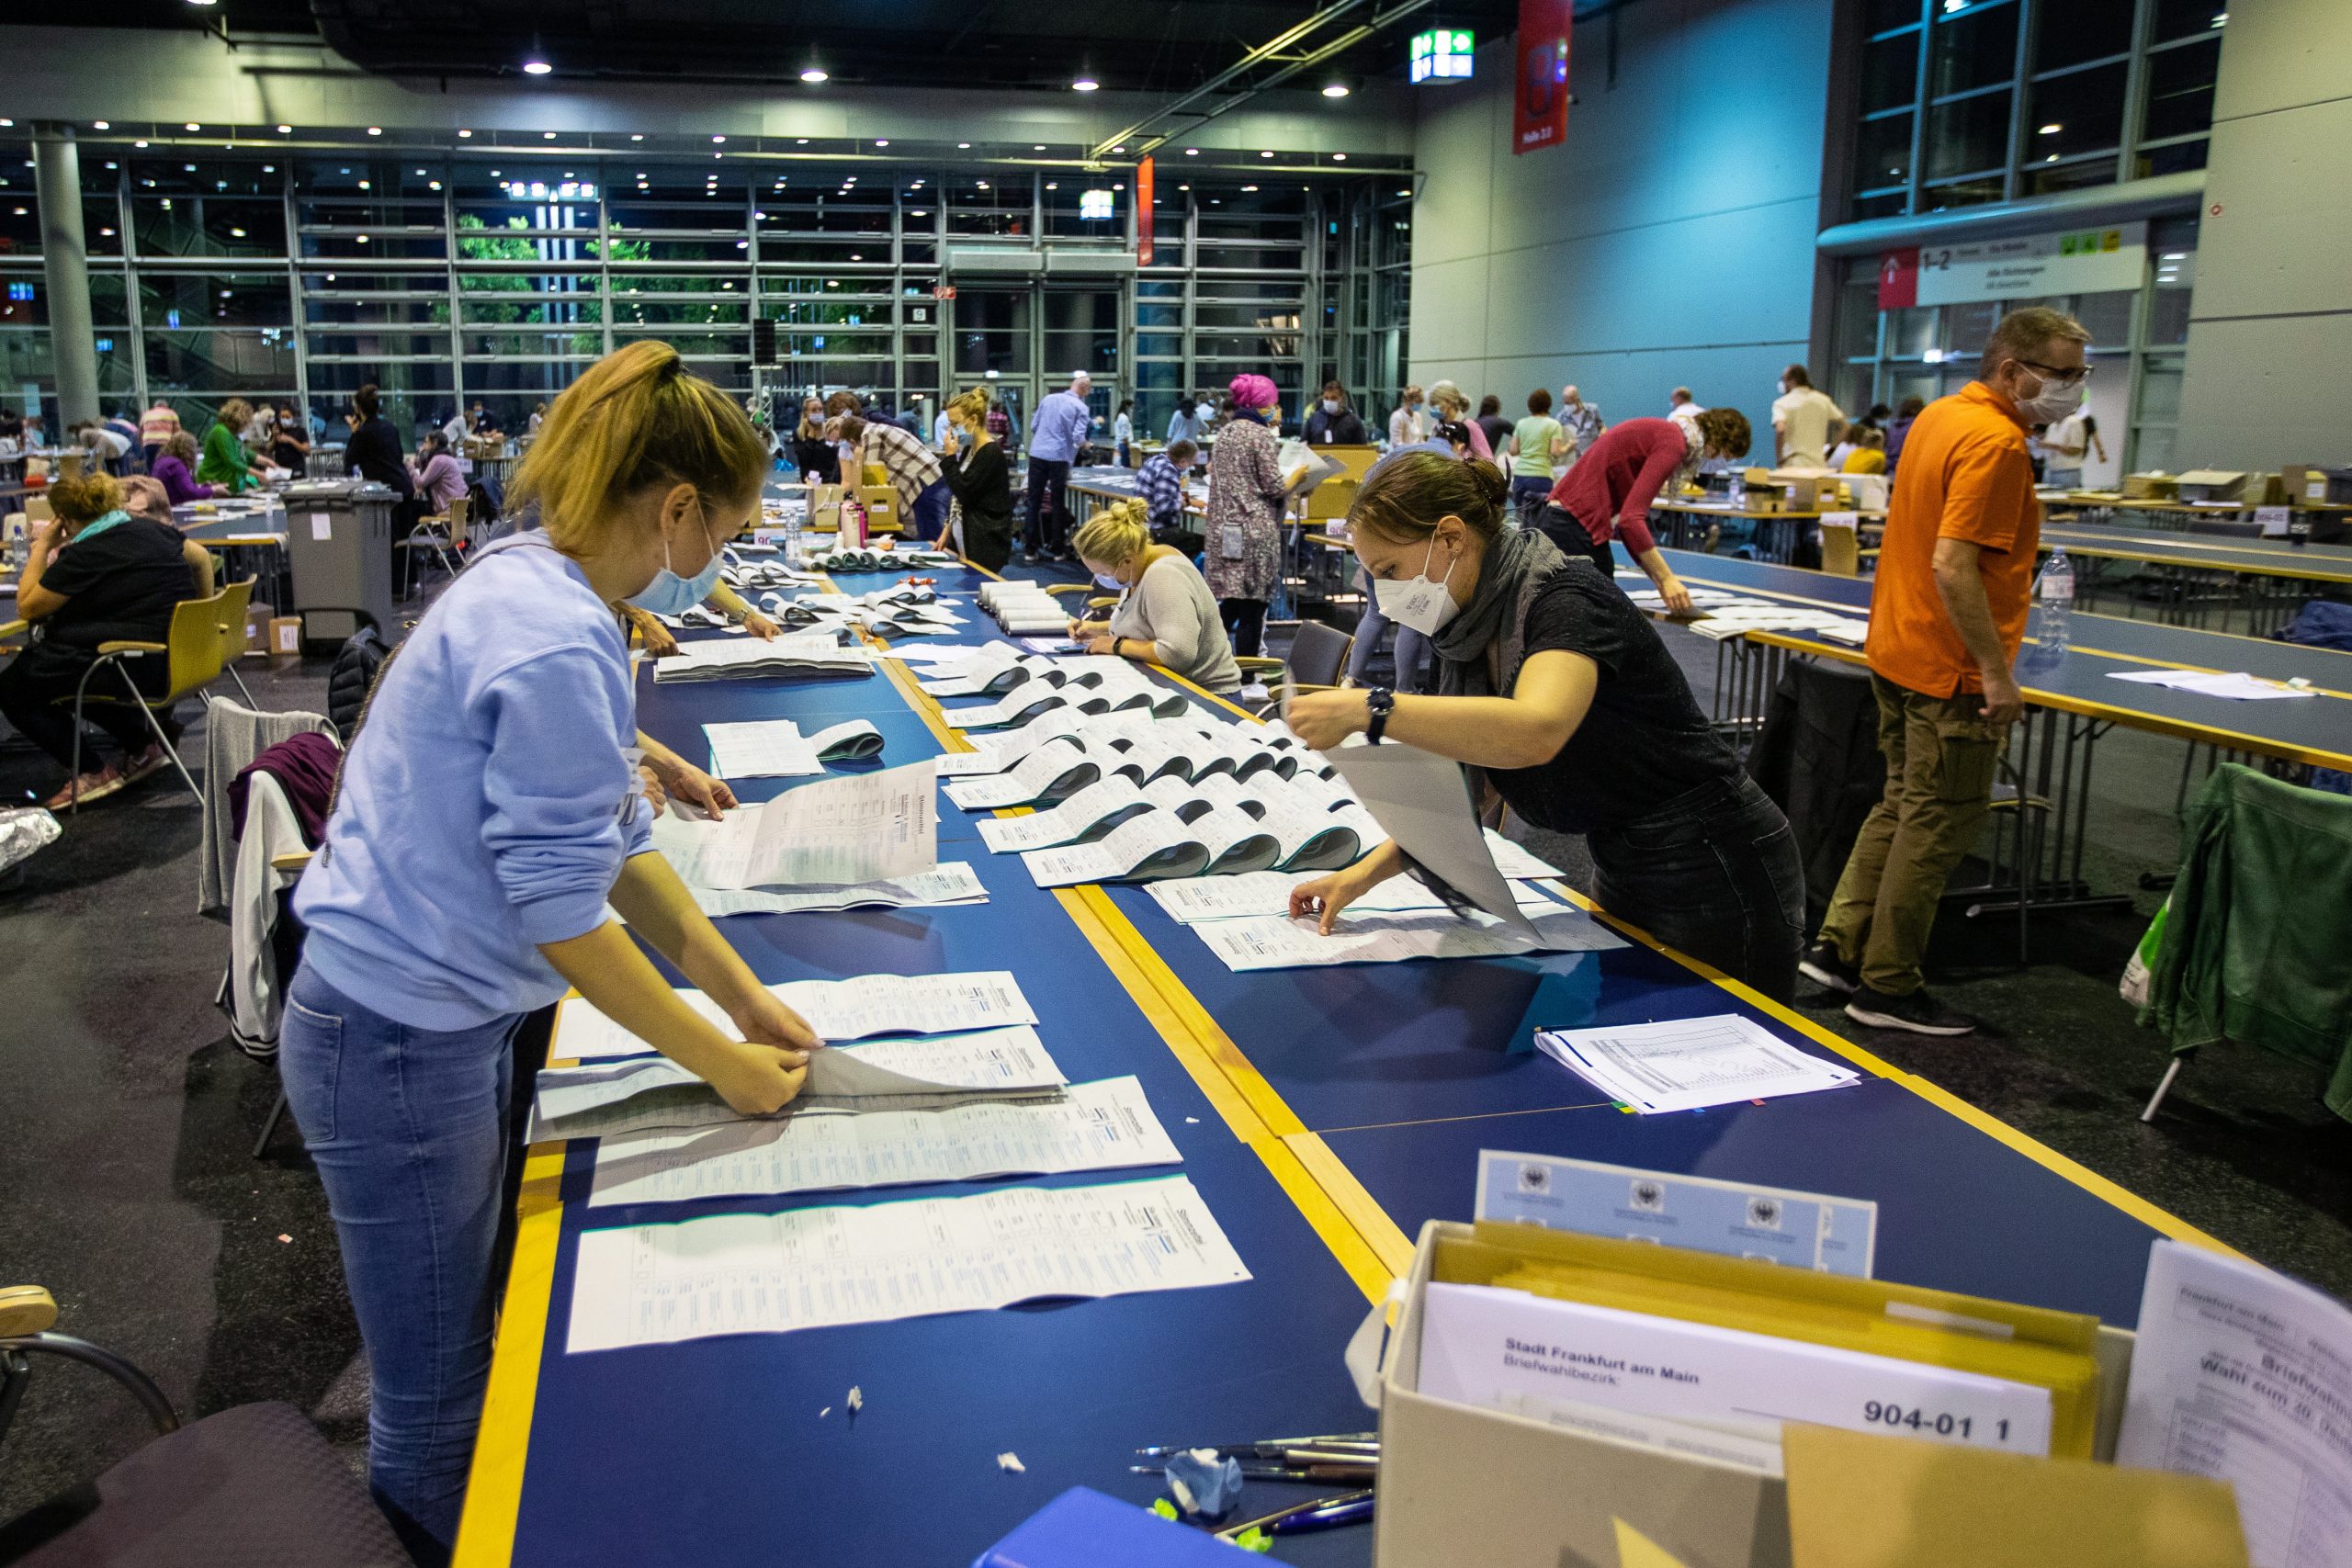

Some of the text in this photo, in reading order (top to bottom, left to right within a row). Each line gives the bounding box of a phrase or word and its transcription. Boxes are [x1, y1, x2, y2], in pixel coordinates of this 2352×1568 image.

[1505, 1337, 1700, 1384] Stadt Frankfurt am Main
[2200, 1357, 2246, 1385] Wahl
[2253, 1381, 2289, 1405] zum
[1864, 1400, 2010, 1440] 904-01 1
